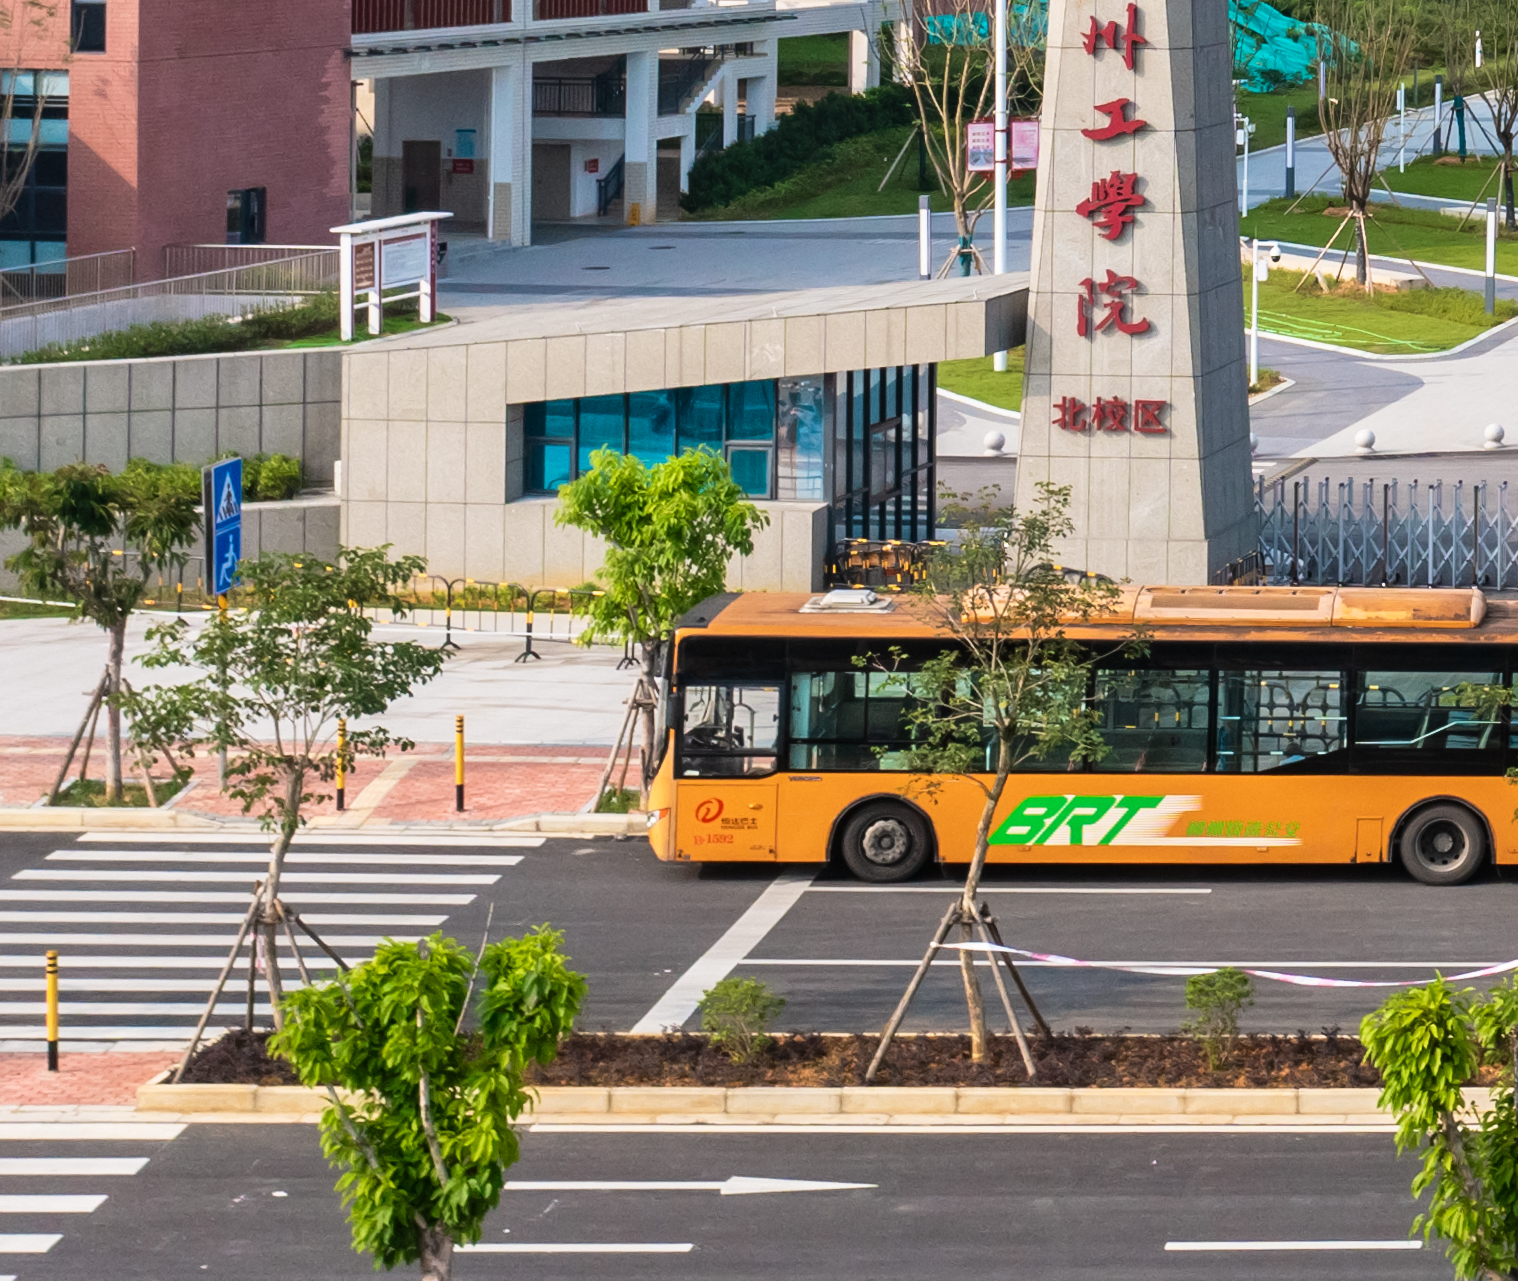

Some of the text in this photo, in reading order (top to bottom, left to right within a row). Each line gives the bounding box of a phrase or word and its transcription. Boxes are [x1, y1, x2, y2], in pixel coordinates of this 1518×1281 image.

[1052, 395, 1168, 434] 北校区
[986, 795, 1167, 846] BRT
